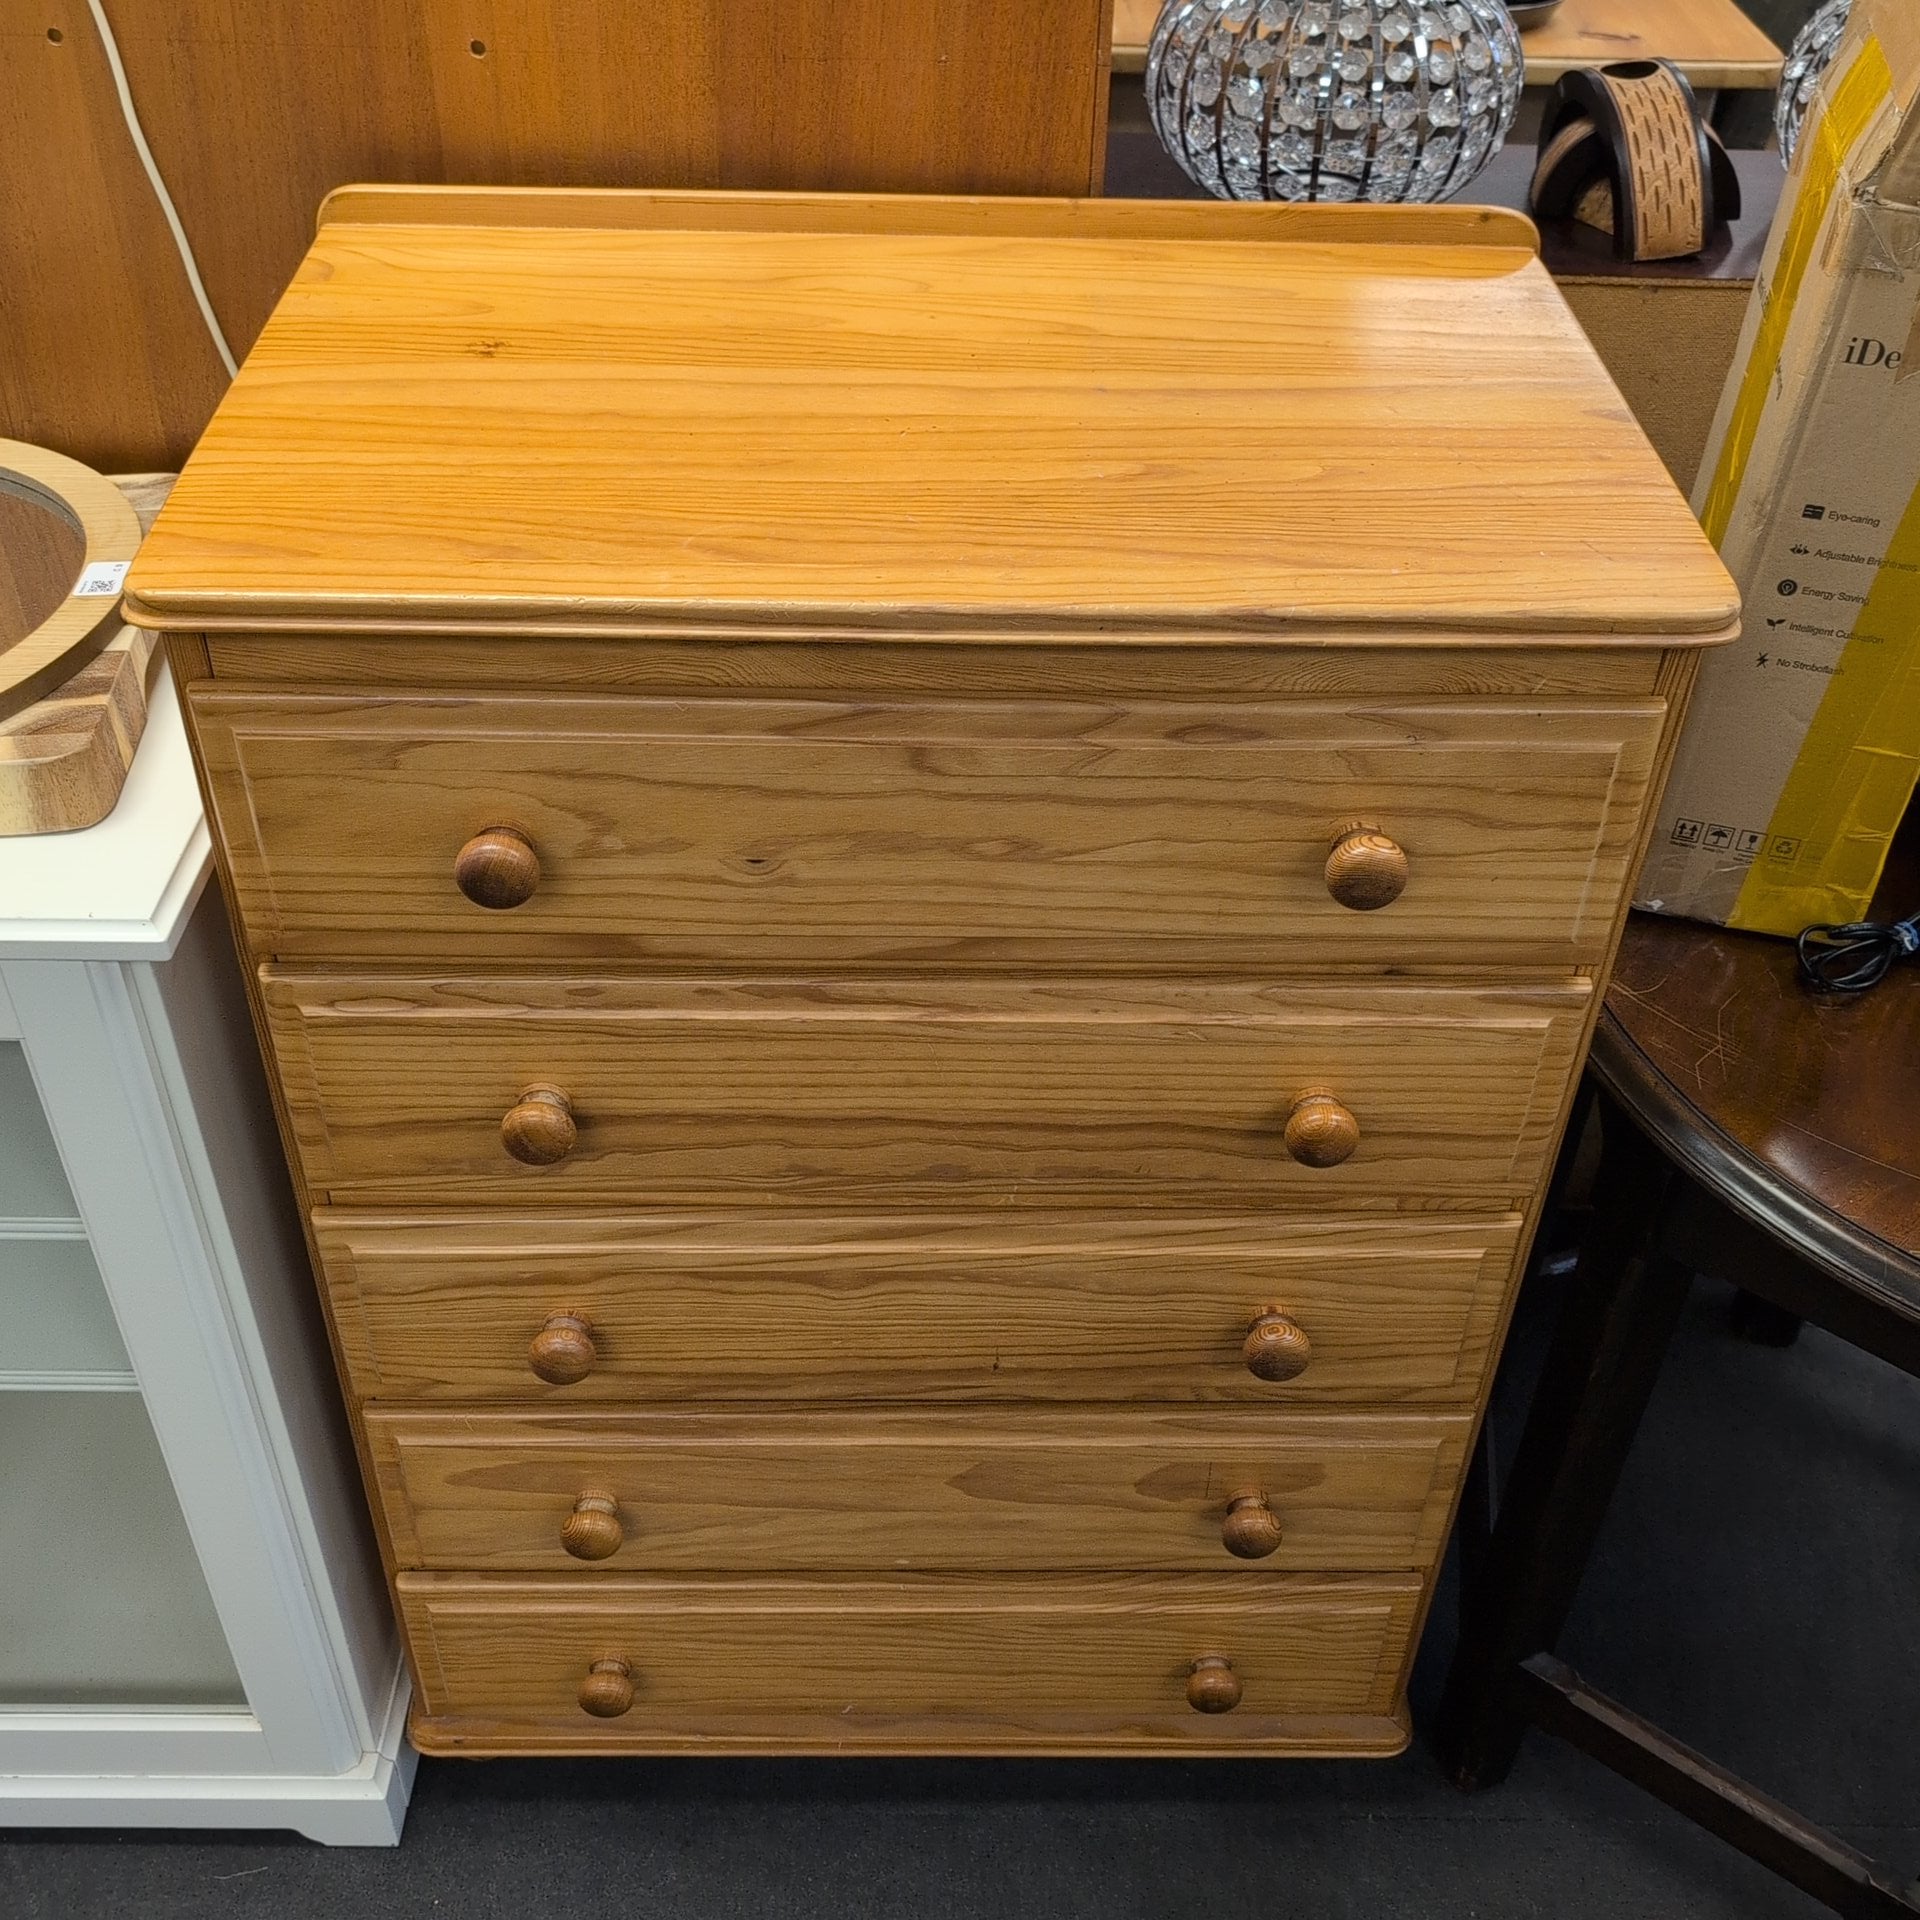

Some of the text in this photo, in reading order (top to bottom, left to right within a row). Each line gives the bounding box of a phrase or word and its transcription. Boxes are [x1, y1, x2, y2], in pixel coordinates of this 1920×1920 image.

[1828, 510, 1880, 528] Eye-caring
[1814, 549, 1865, 564] Adjustable
[1801, 586, 1870, 606] Energy Saving
[1789, 622, 1834, 636] Intelligent
[1776, 658, 1790, 667] No
